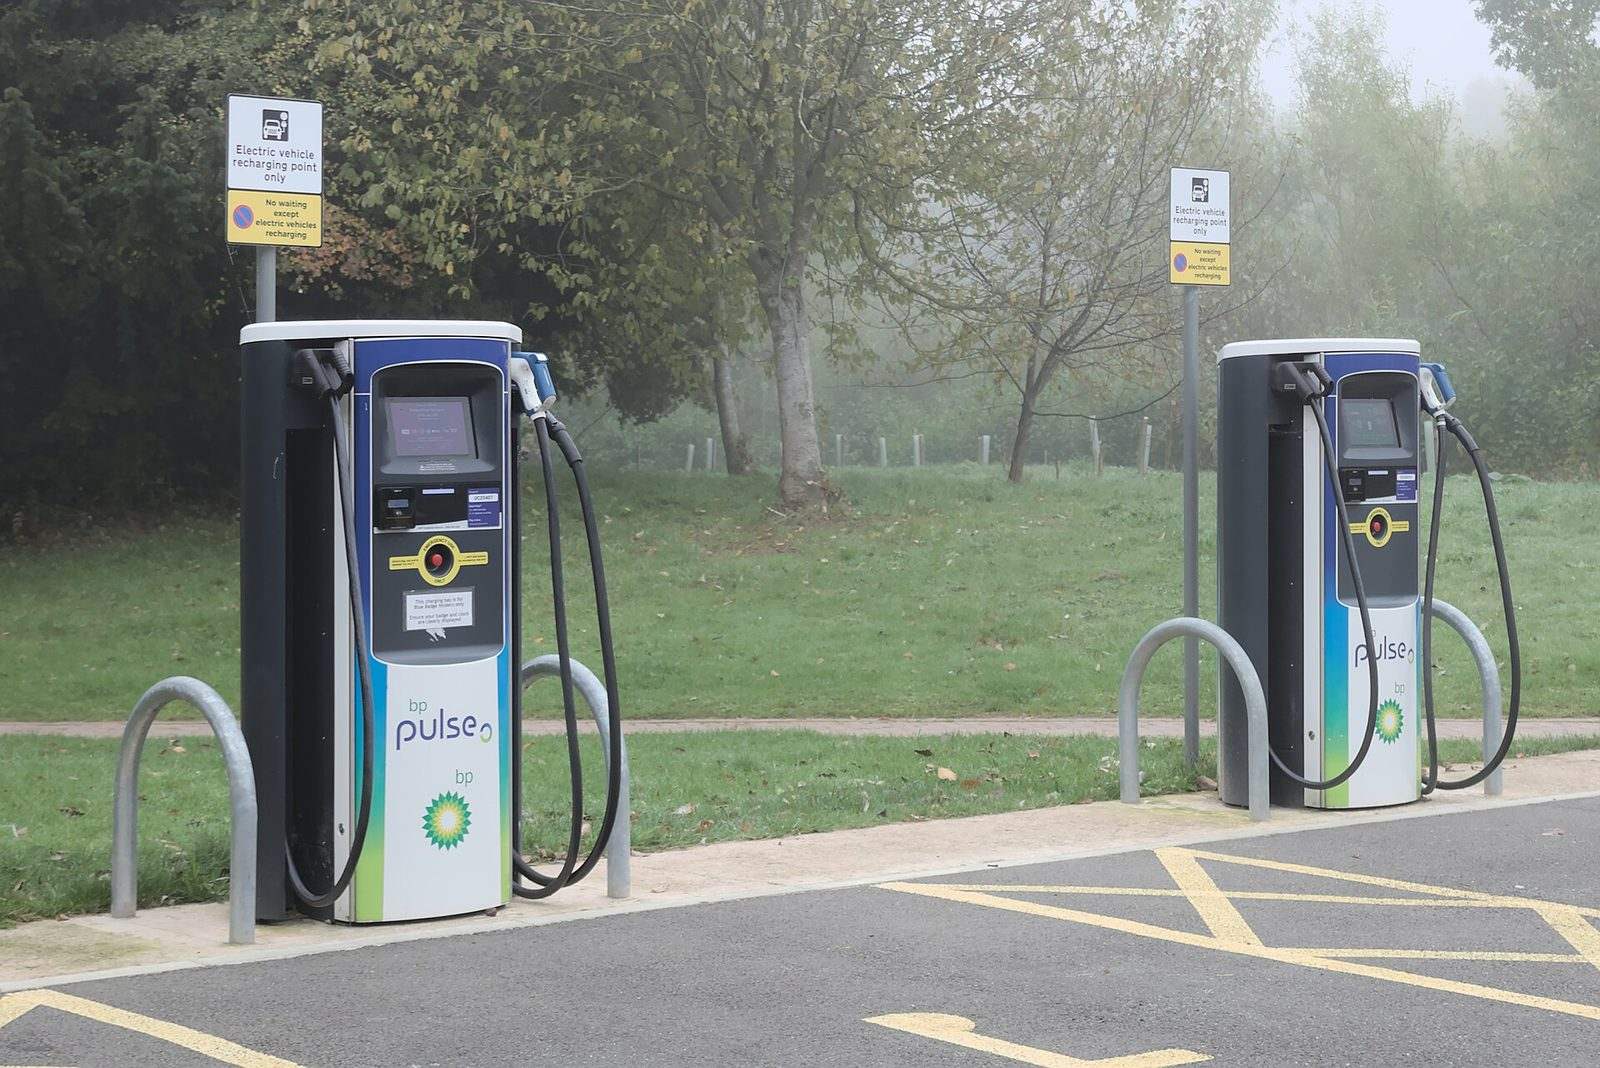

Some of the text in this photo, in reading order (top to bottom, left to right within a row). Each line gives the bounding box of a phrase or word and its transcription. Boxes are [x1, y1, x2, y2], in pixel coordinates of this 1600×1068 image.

[236, 144, 315, 160] Electric vehicle
[233, 158, 317, 173] recharging point
[264, 173, 286, 184] only
[265, 199, 307, 209] No waiting
[273, 210, 299, 218] except
[1175, 205, 1225, 217] Electric vehicle
[255, 219, 317, 229] electric vehicles
[1173, 217, 1227, 227] recharging point
[265, 230, 307, 240] recharging
[1193, 228, 1207, 236] only
[1394, 681, 1405, 696] bp
[408, 698, 428, 715] bp
[395, 708, 478, 751] pulse
[455, 768, 474, 787] bp
